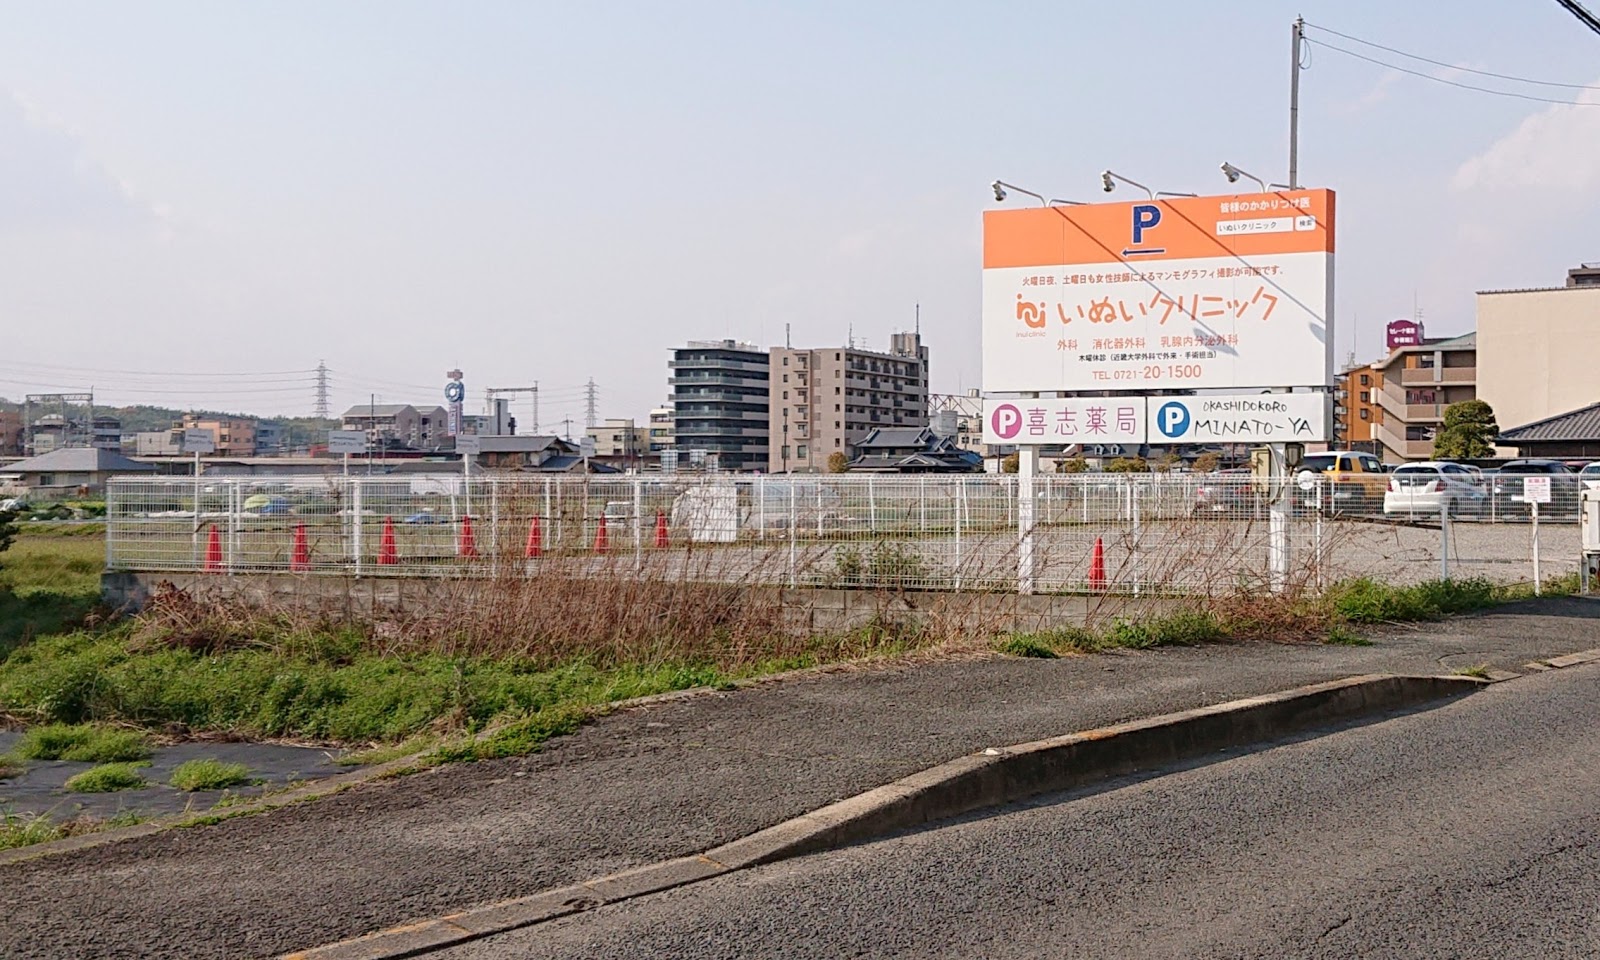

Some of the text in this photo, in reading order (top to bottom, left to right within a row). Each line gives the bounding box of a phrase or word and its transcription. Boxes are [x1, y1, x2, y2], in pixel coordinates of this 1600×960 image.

[1220, 197, 1311, 213] 皆様のかかりつけ医
[1132, 205, 1161, 244] P
[1219, 221, 1277, 232] いぬいクリニック
[1057, 286, 1278, 325] いぬいクリニック
[1057, 334, 1239, 351] 外科 消化器外科 乳腺内分泌外科
[1092, 364, 1202, 380] TEL 0721-20-1500
[1203, 400, 1287, 412] OKASHIDOKORO
[999, 409, 1017, 435] P
[1026, 406, 1137, 436] 喜志薬局
[1165, 407, 1184, 433] P
[1194, 417, 1315, 436] MINATO-YA
